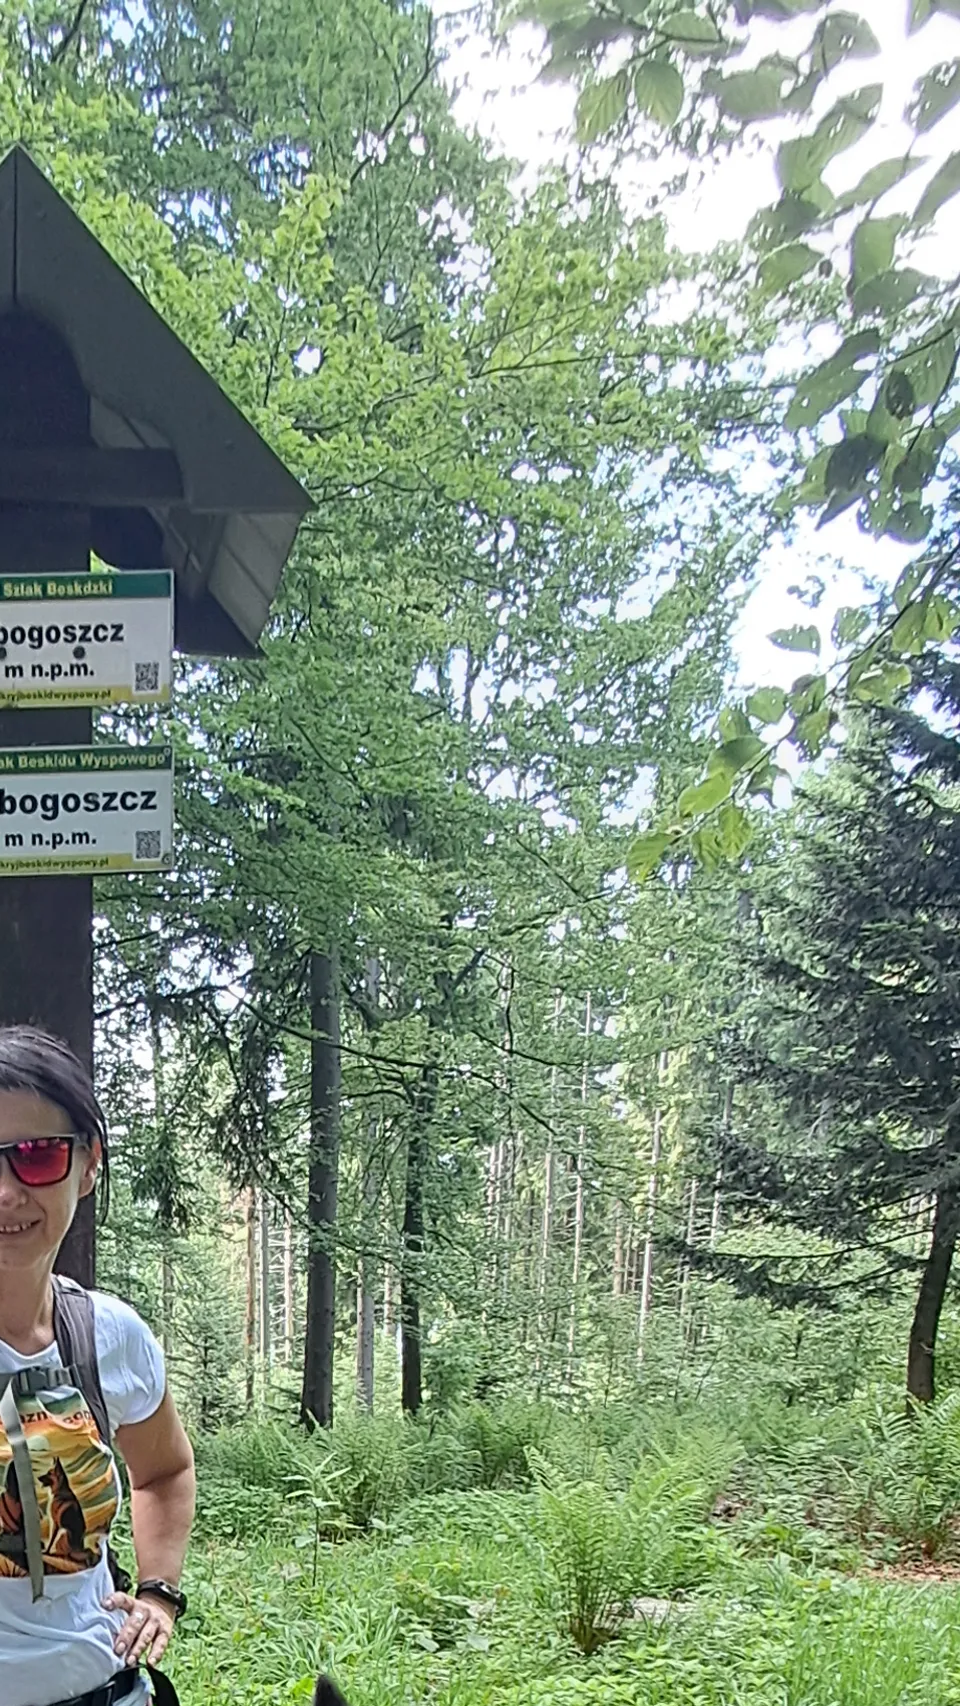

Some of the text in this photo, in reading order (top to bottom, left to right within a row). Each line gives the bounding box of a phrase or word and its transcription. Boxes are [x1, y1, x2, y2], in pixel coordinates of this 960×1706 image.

[4, 581, 43, 598] Szlak
[4, 664, 24, 679] m
[30, 662, 96, 682] n.p.m.
[19, 754, 77, 769] Beskidu
[79, 752, 166, 770] Wyspowego
[4, 832, 24, 848] m
[30, 829, 98, 850] n.p.m.
